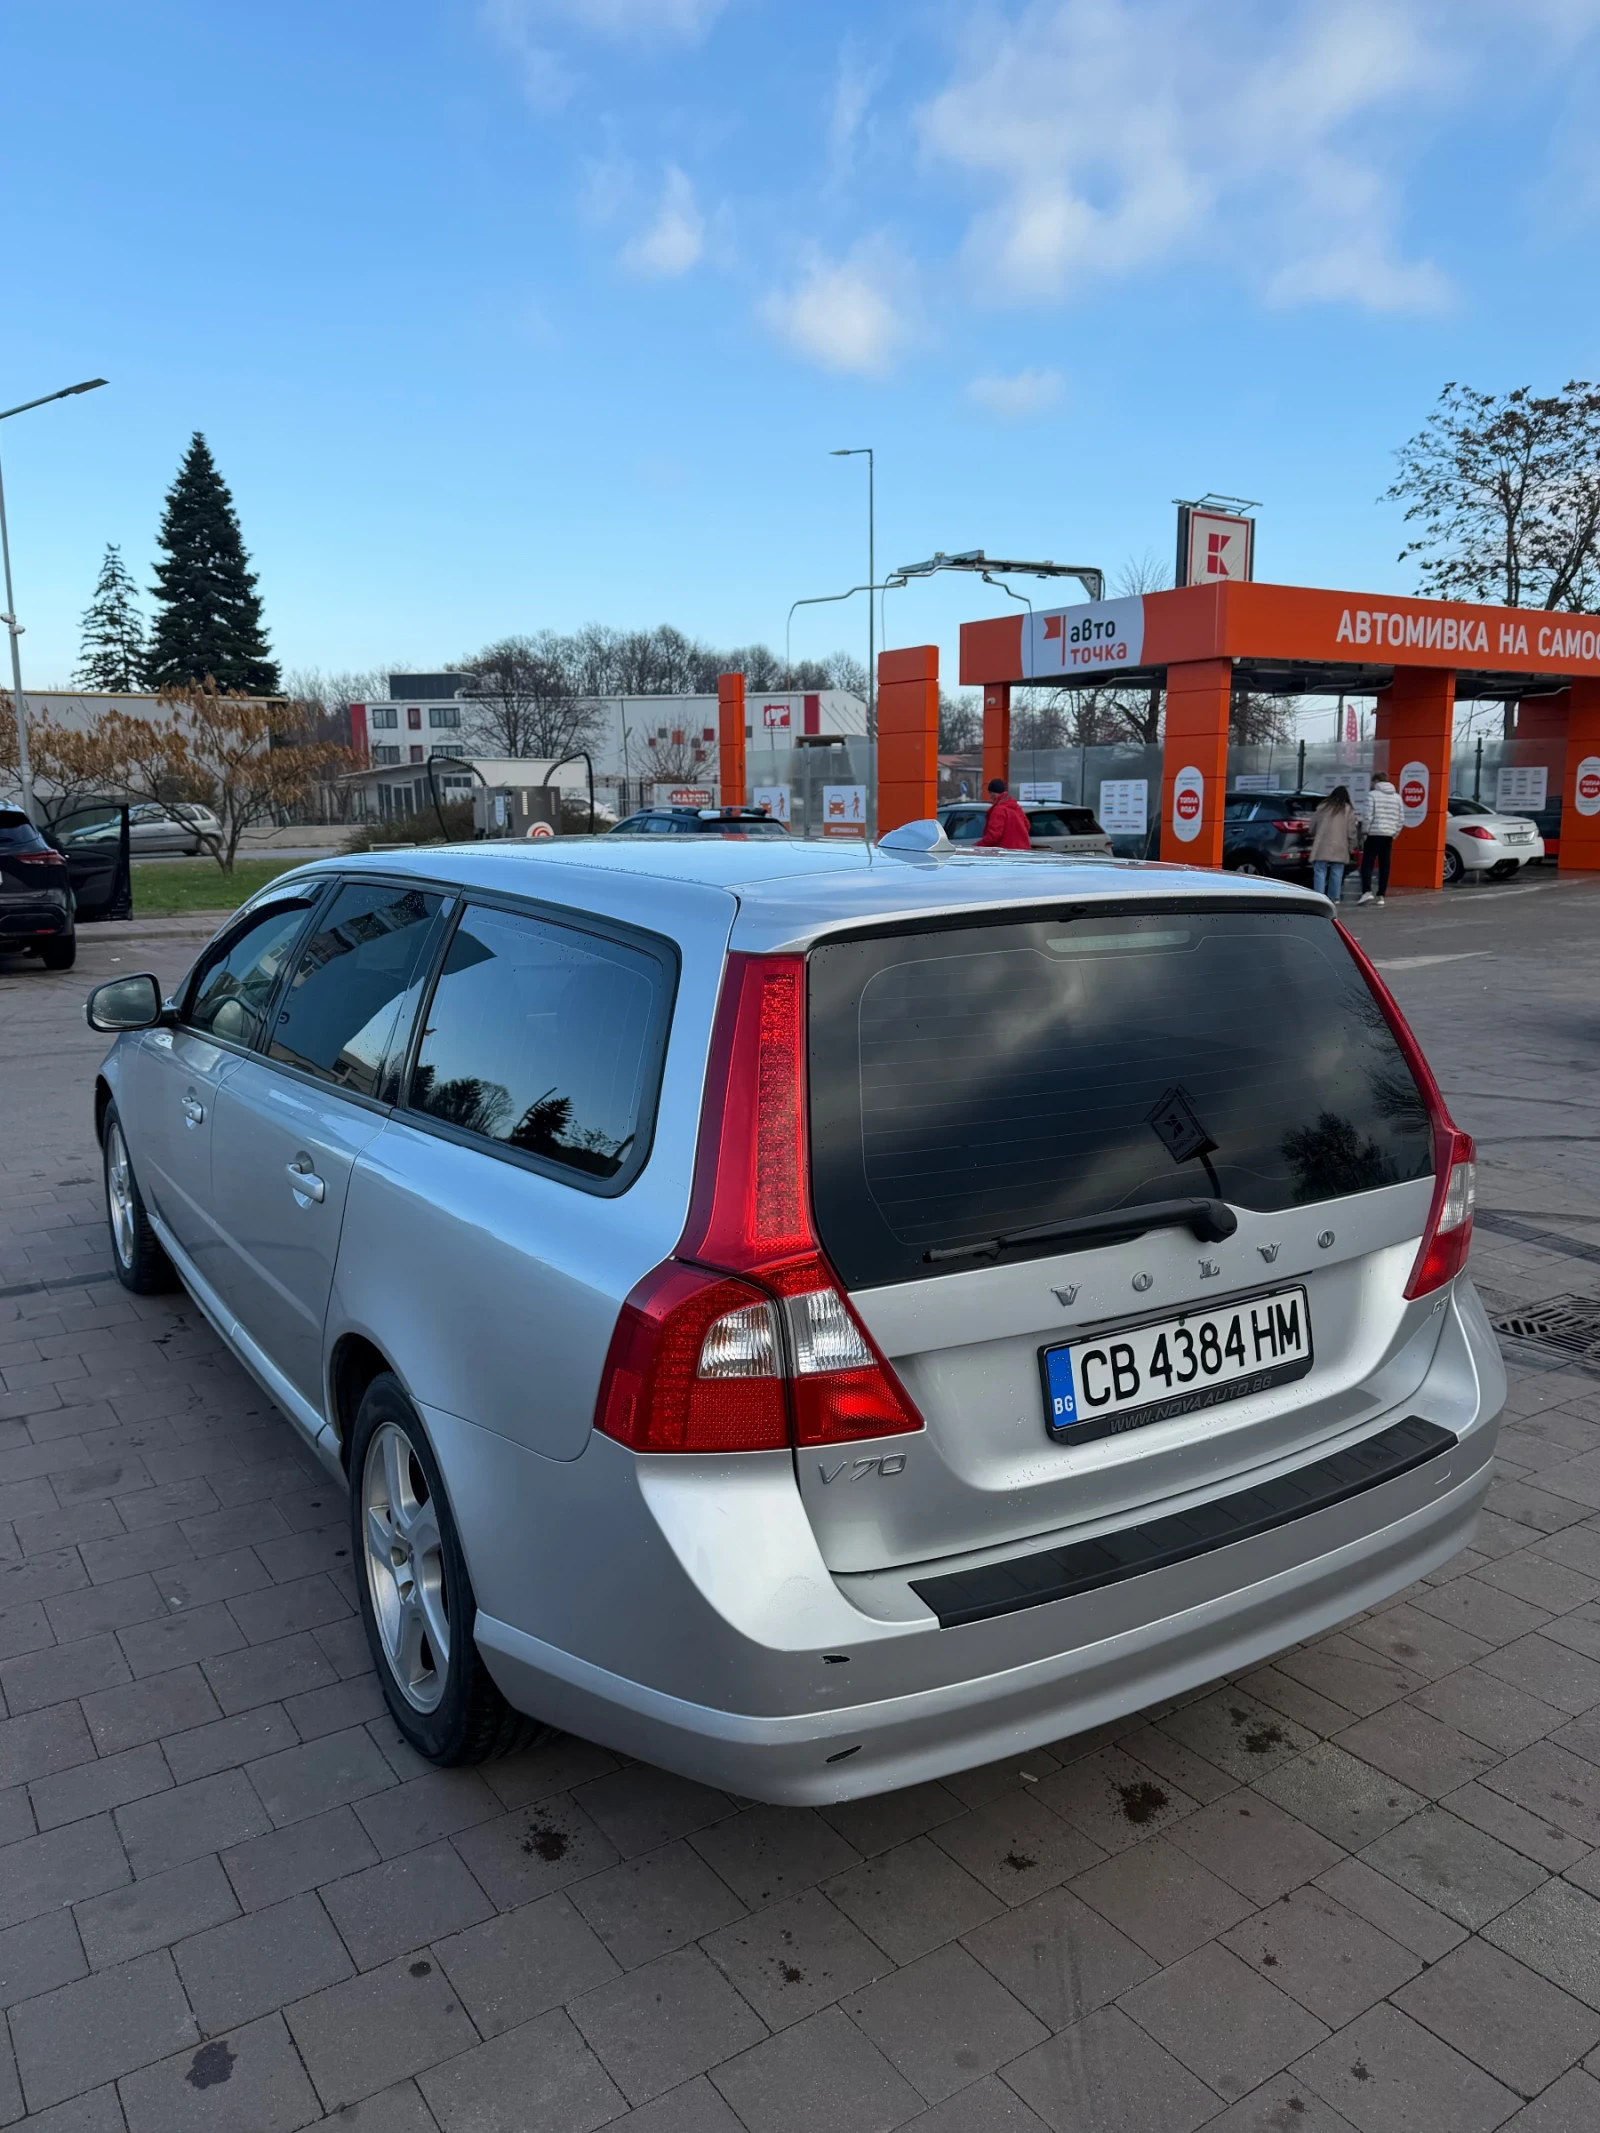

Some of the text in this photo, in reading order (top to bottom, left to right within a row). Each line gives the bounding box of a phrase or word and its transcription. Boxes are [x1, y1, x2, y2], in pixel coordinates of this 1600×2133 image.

[1070, 618, 1116, 643] авто
[1336, 609, 1489, 652] АВТОМИВКА
[1499, 623, 1528, 655] НА
[1070, 642, 1128, 665] точка
[1051, 1229, 1335, 1306] VOLVO
[1149, 1314, 1246, 1388] 4384
[1251, 1300, 1301, 1362] HM
[1053, 1395, 1074, 1415] BG
[818, 1452, 907, 1485] V70
